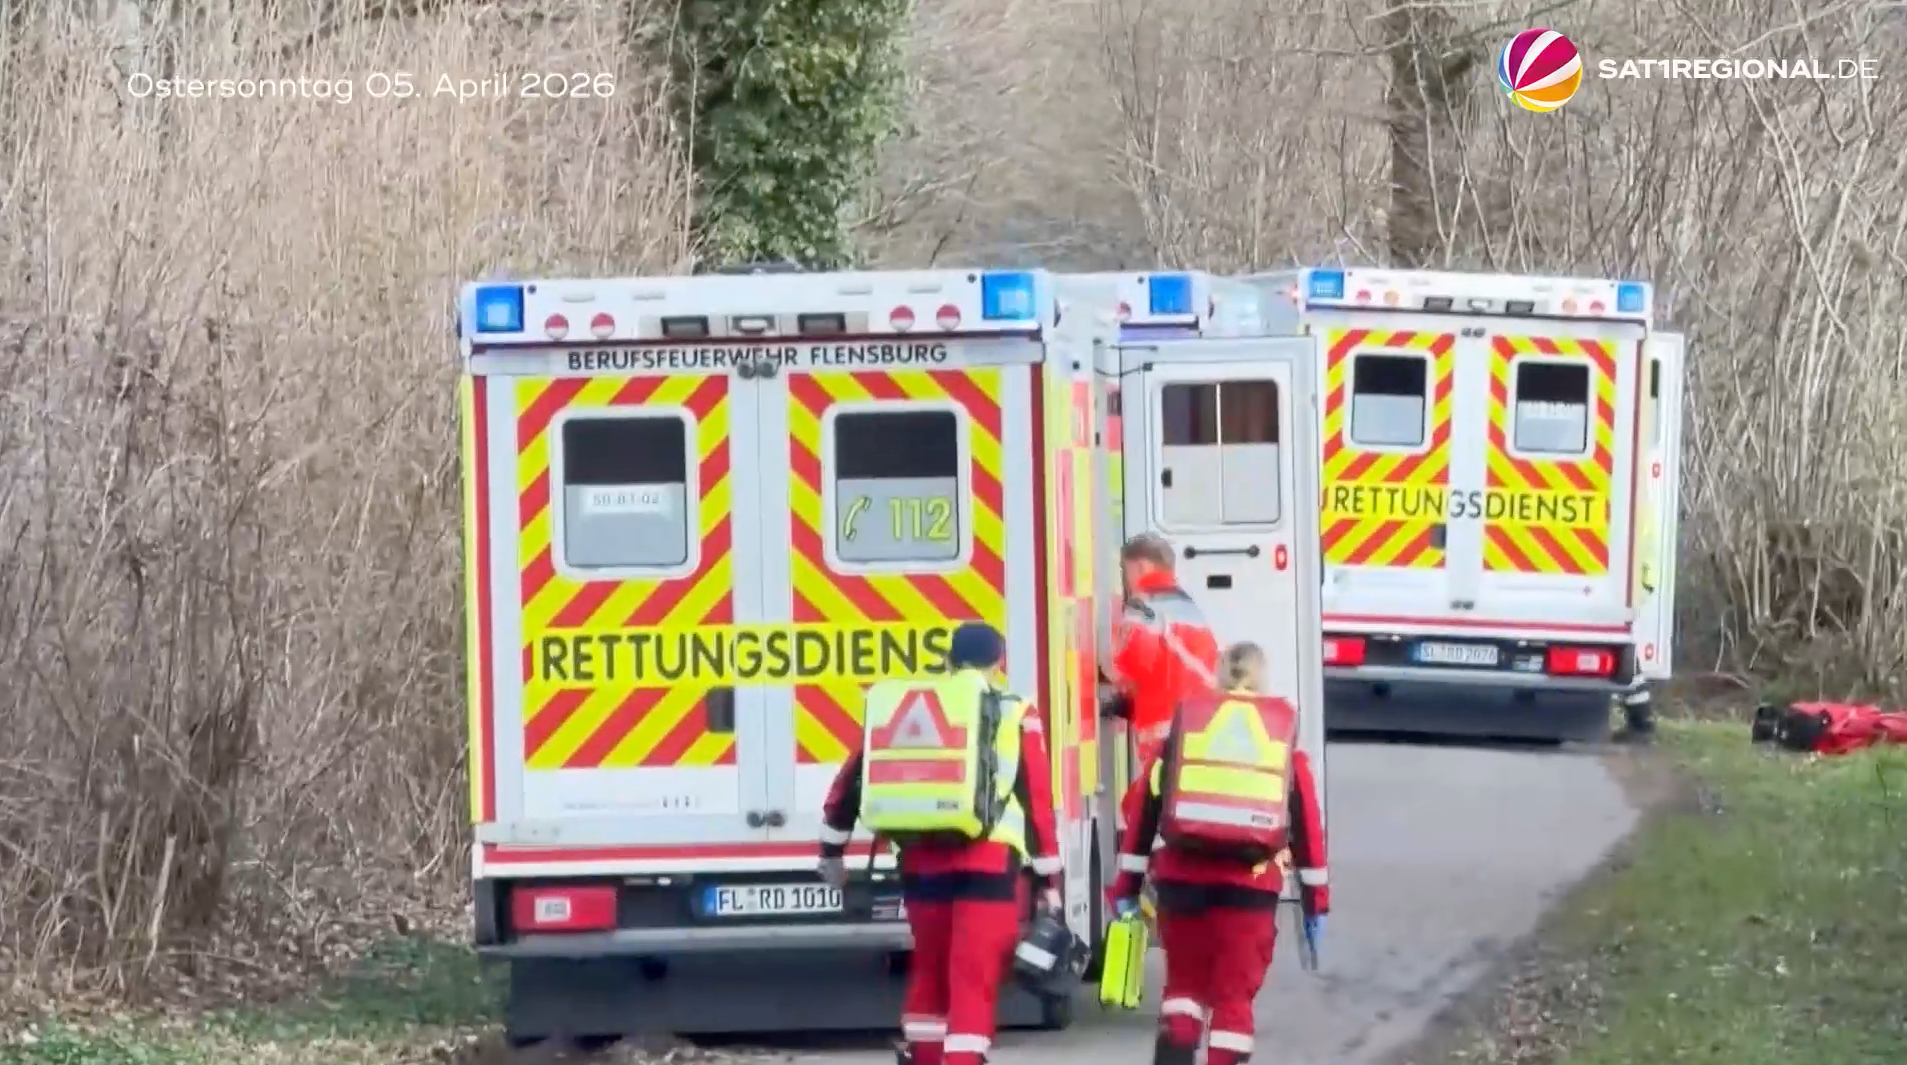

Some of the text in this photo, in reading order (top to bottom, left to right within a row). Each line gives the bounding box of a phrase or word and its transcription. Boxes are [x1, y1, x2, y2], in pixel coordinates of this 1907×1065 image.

[567, 343, 948, 371] BERUFSFEUERWEHR FLENSBURG
[889, 497, 951, 540] 112
[1333, 484, 1596, 523] RETTUNGSDIENST
[541, 627, 952, 681] RETTUNGSDIENS
[718, 889, 743, 912] FL
[759, 888, 785, 910] RD
